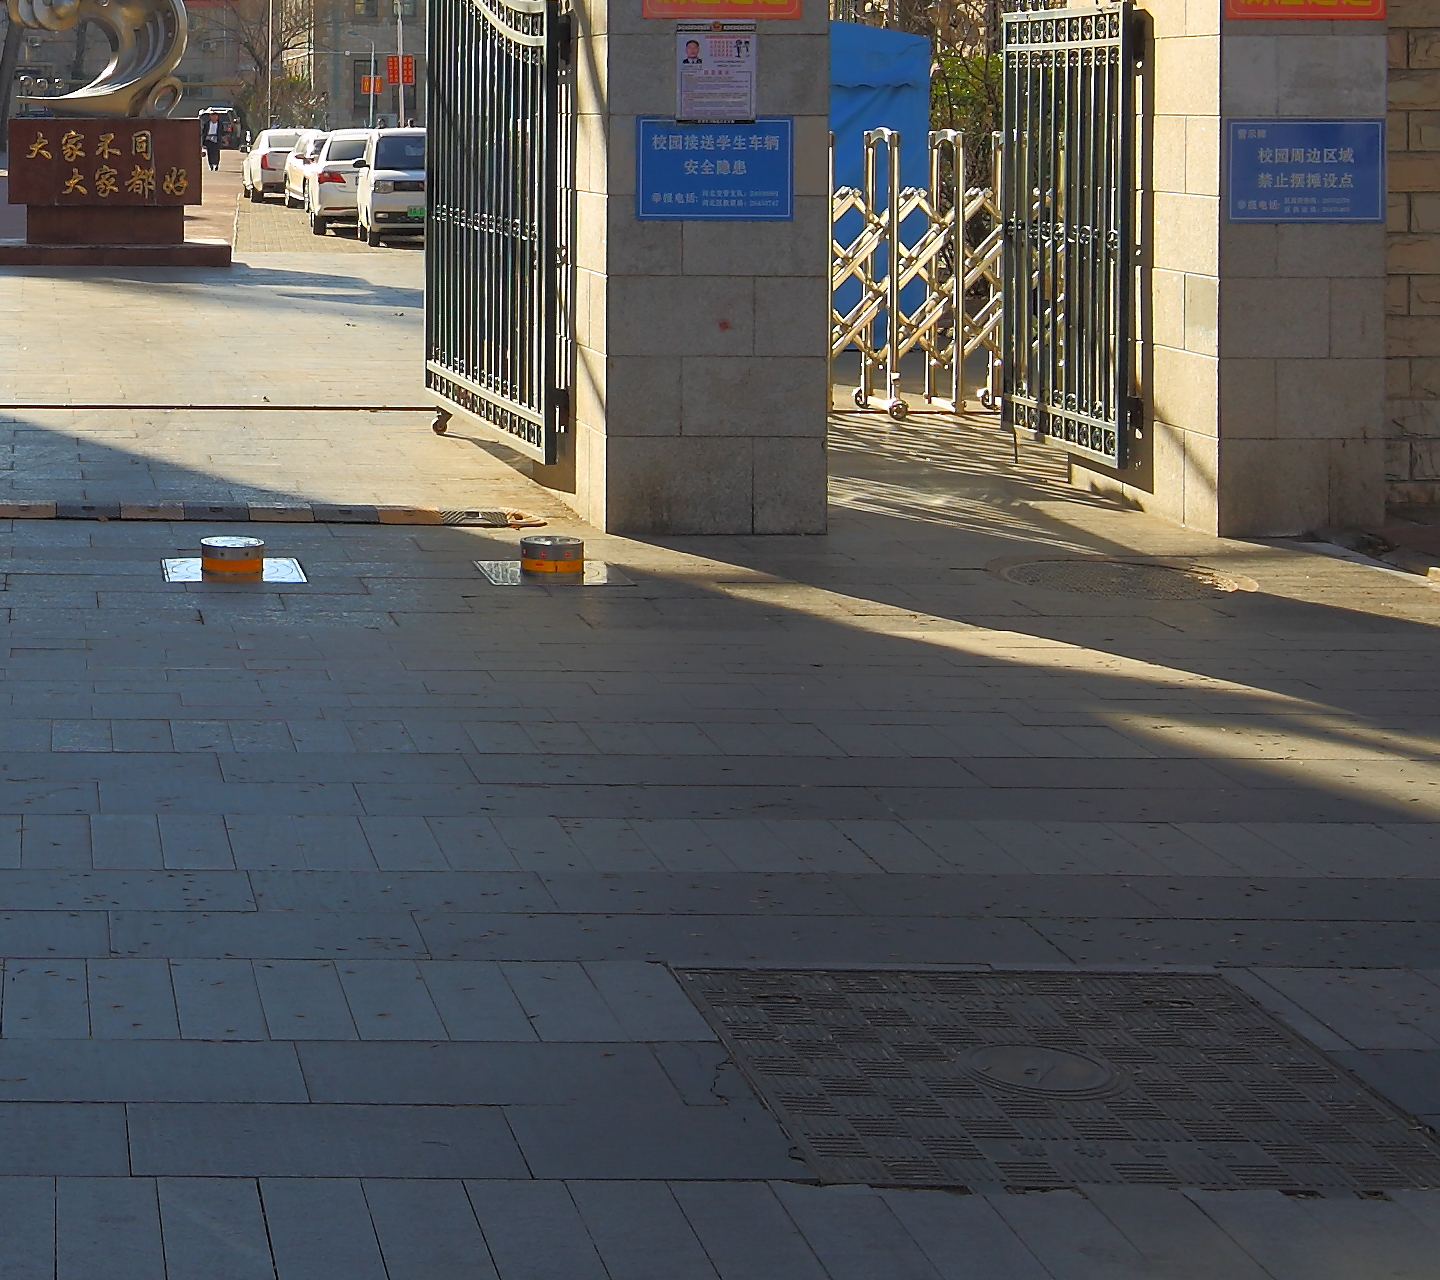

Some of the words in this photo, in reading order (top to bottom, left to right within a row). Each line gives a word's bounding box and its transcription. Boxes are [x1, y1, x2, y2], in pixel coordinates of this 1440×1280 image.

[26, 130, 152, 162] 大家不同
[652, 135, 780, 151] 校园接送学生车辆
[1258, 148, 1355, 163] 校园周边区域
[685, 159, 747, 175] 安全隐患
[62, 164, 189, 199] 大家都好
[1258, 173, 1354, 188] 禁止摆摊设点
